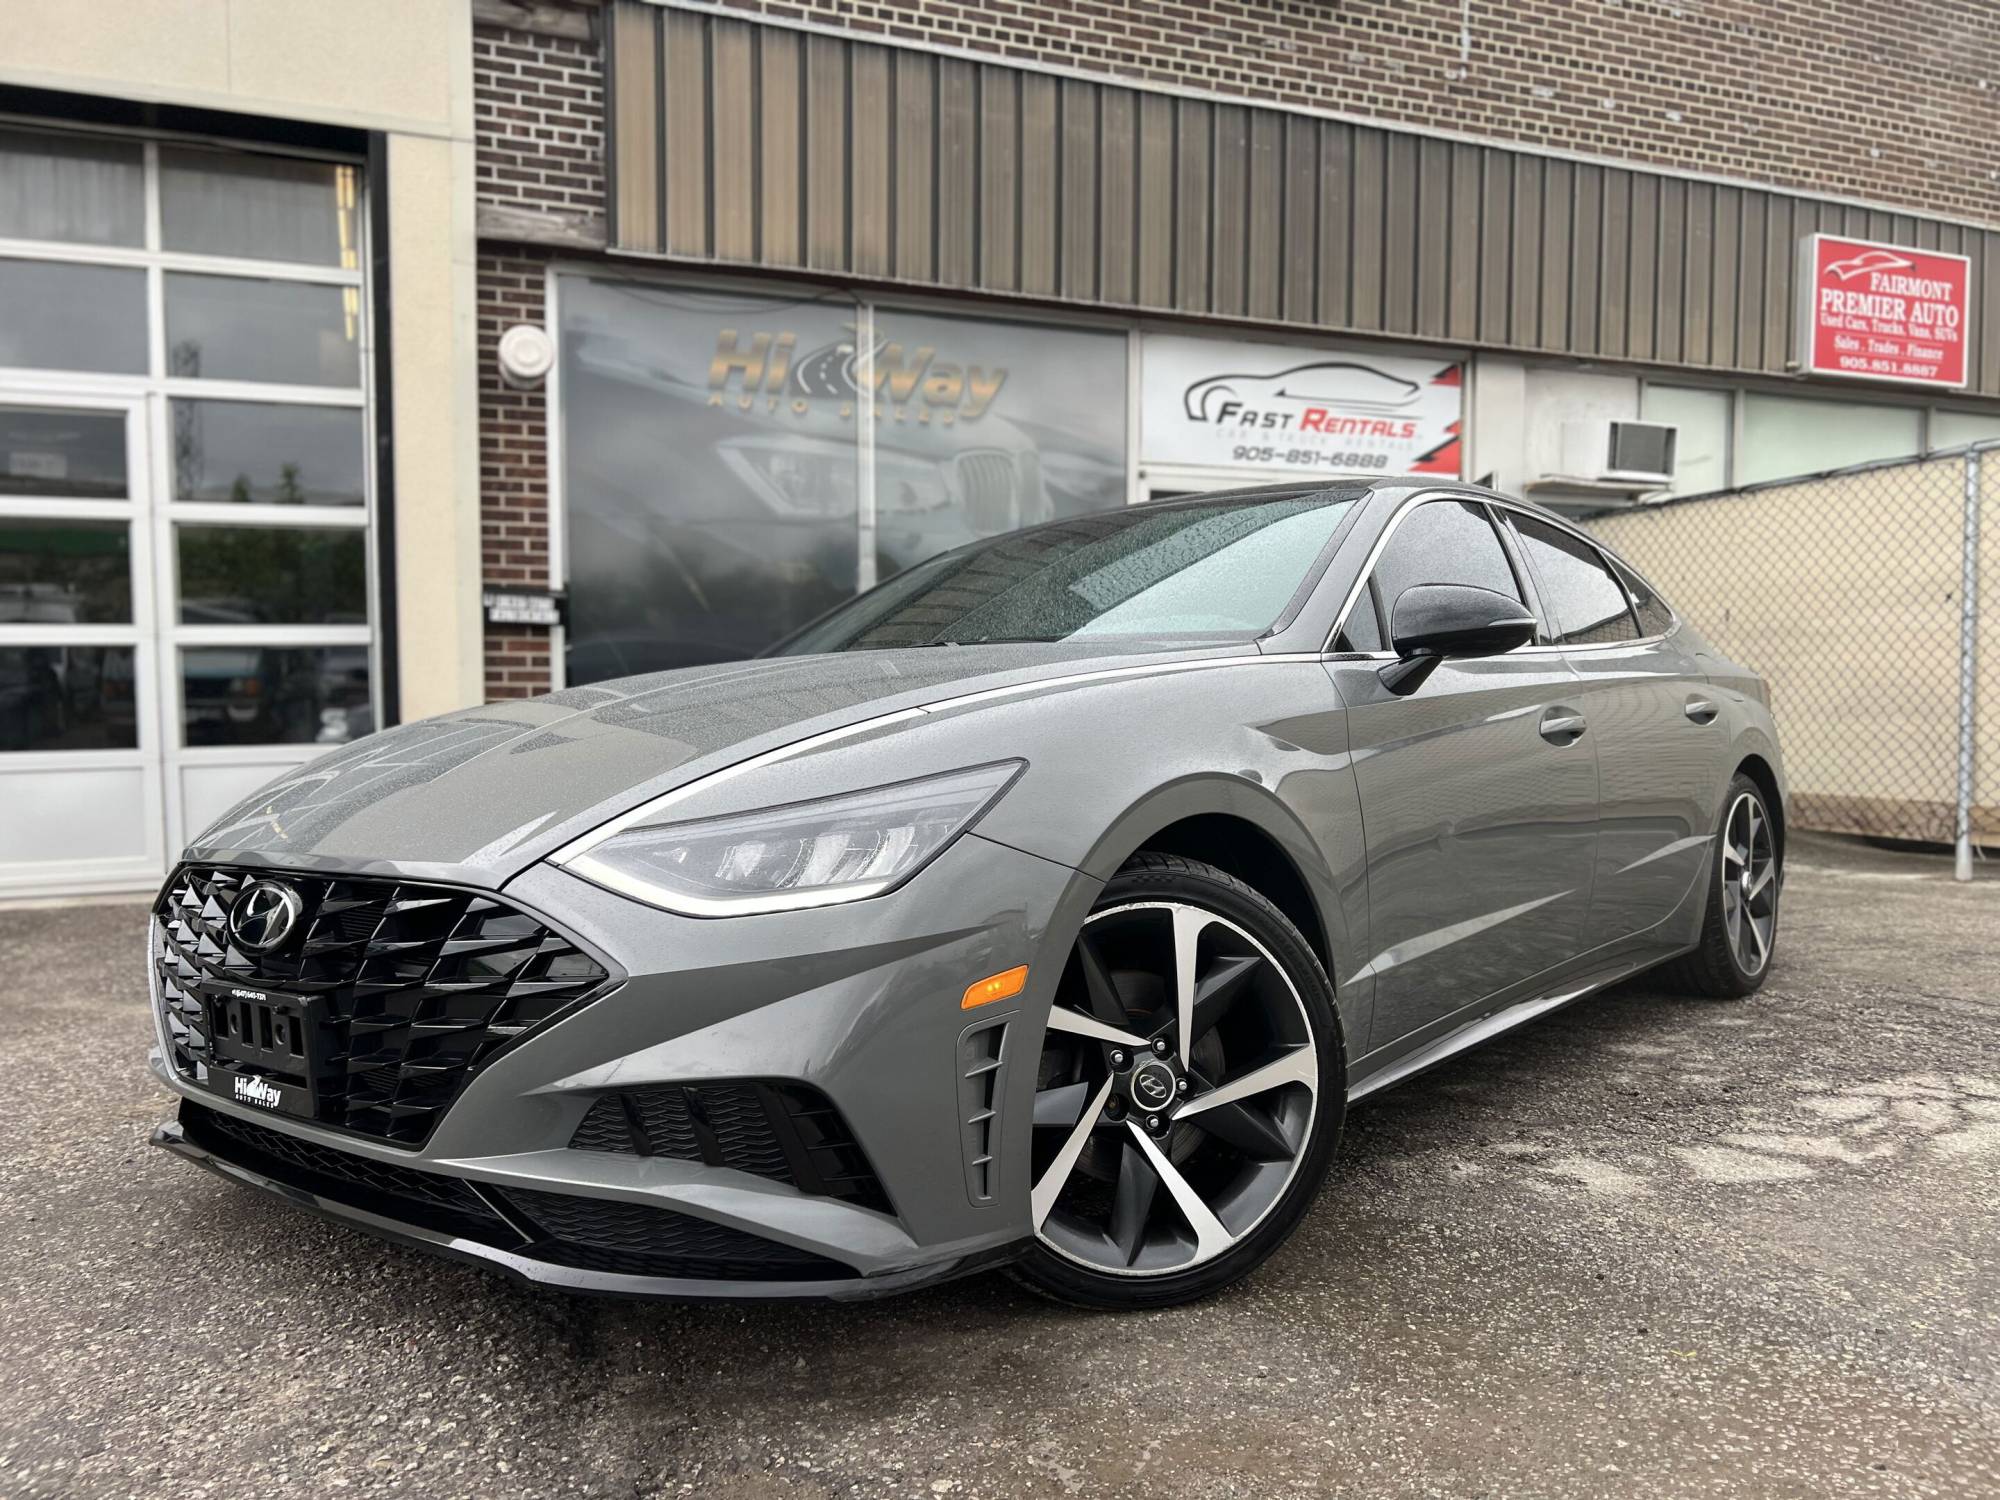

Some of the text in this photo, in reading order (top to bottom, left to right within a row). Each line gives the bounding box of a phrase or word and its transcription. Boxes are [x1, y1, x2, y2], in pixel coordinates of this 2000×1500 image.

[1870, 272, 1953, 301] FAIRMONT
[1820, 288, 1959, 328] PREMIER AUTO
[1820, 312, 1843, 329] Used
[1907, 343, 1944, 361] Finance
[708, 329, 1009, 420] Hi Way
[1216, 402, 1417, 439] FAST RENTALS
[1232, 446, 1389, 469] 905-851-6888
[234, 1076, 282, 1107] Hi Way
